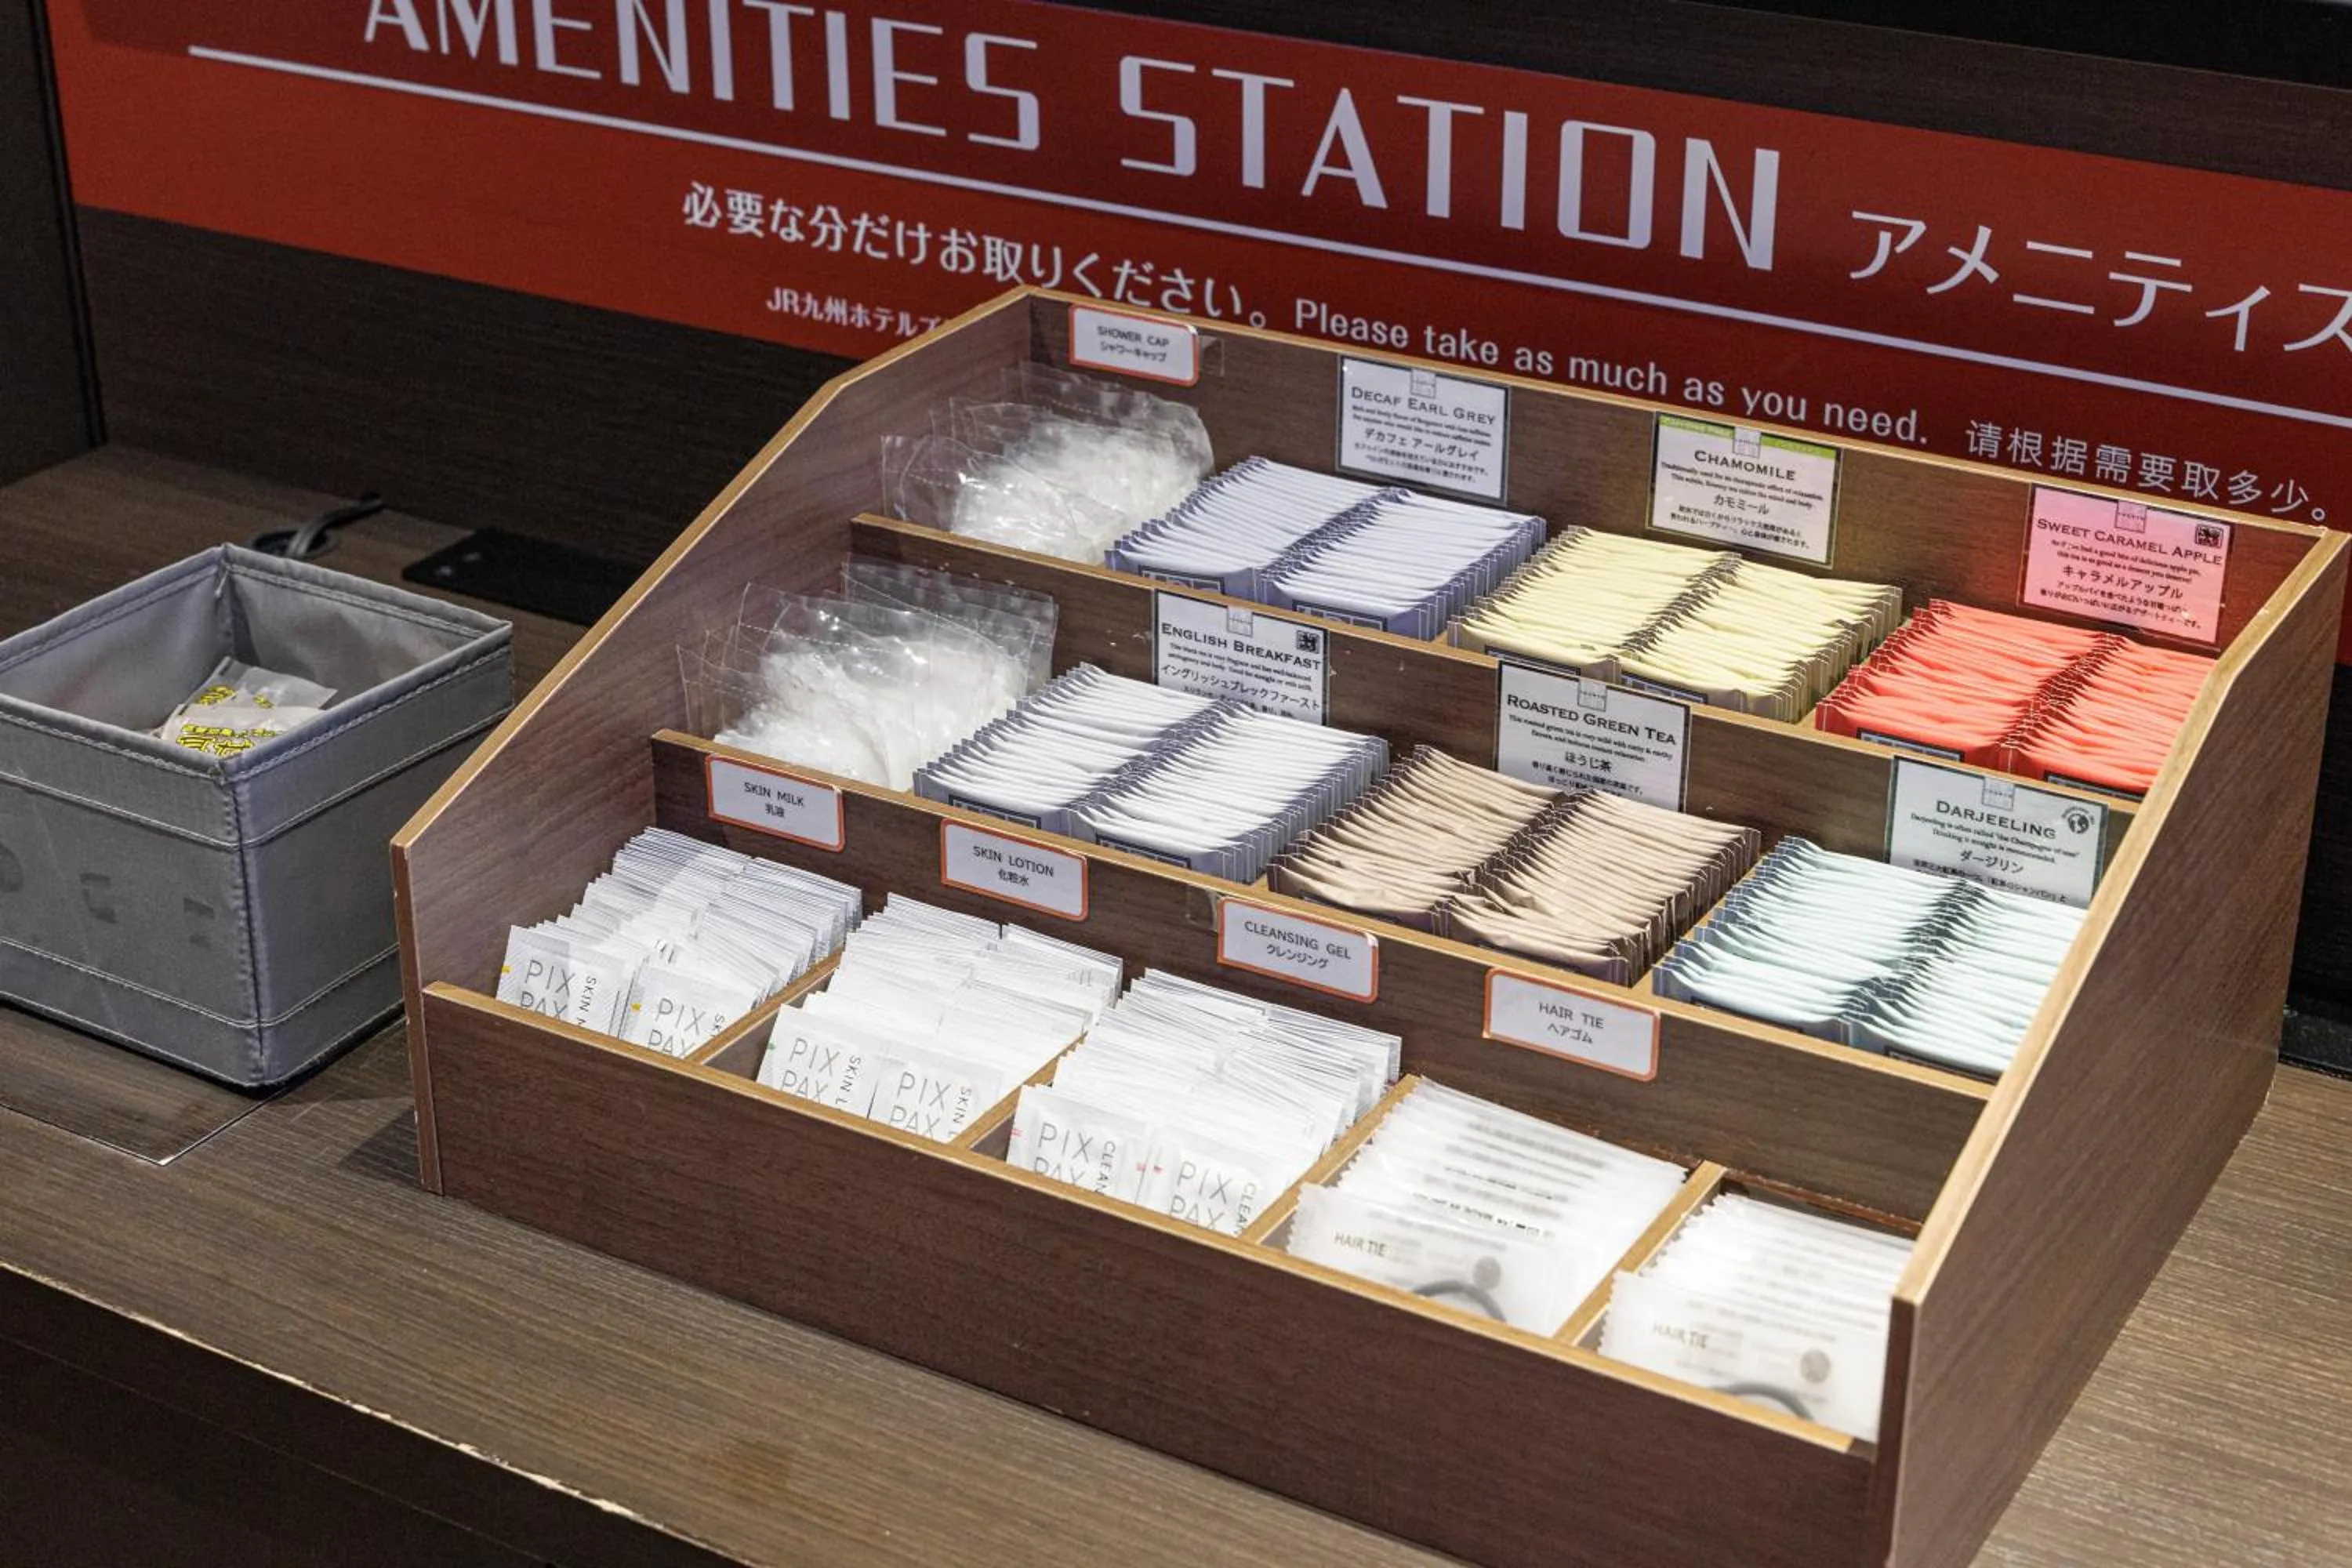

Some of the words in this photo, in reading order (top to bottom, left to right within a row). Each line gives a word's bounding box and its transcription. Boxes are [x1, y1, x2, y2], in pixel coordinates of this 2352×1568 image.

[1119, 55, 1780, 271] STATION
[683, 181, 1265, 329] 必要な分だけお取りください。
[1097, 325, 1142, 343] SHOWER
[1146, 335, 1170, 347] CAP
[1295, 298, 1410, 349] Please
[1424, 325, 1499, 366] take
[1514, 347, 1554, 376] as
[1568, 356, 1668, 396] much
[1683, 377, 1725, 407] as
[1740, 387, 1807, 421] you
[1824, 402, 1928, 445] need.
[1351, 386, 1403, 406] DECAF
[1407, 397, 1449, 417] EARL
[1453, 407, 1497, 426] GREY
[1693, 449, 1796, 481] CHAMOMILE
[1965, 419, 2327, 522] 请根据需要取多少。
[1713, 494, 1770, 516] カモミール
[2037, 518, 2092, 539] SWEET
[2094, 529, 2168, 556] CARAMEL
[2171, 546, 2223, 566] APPLE
[2062, 564, 2183, 600] キャラメルアップル
[1160, 622, 1228, 649] ENGLISH
[1232, 639, 1321, 671] BREAKFAST
[1160, 662, 1320, 711] イングリッシュブレックファースト
[1506, 693, 1580, 723] ROASTED
[1582, 713, 1640, 738] GREEN
[1644, 726, 1677, 746] TEA
[1564, 750, 1613, 774] ほうじ茶
[743, 781, 771, 798] SKIN
[777, 790, 805, 808] MILK
[764, 803, 785, 818] 乳液
[1936, 800, 2057, 840] DARJEELING
[973, 845, 1003, 863] SKIN
[1008, 855, 1054, 877] LOTION
[997, 868, 1029, 887] 化粧水
[1959, 848, 2024, 875] ダージリン
[1244, 920, 1319, 950] CLEANSING
[1326, 942, 1352, 960] GEL
[1265, 943, 1330, 969] クレンジング
[524, 959, 576, 998] PIX
[655, 997, 706, 1036] PIX
[1538, 1000, 1573, 1021] HAIR
[1581, 1012, 1606, 1029] TIE
[1547, 1022, 1594, 1044] ヘアゴム
[789, 1037, 841, 1077] PIX
[896, 1071, 952, 1112] PIX
[1038, 1121, 1094, 1163] PIX
[1177, 1160, 1233, 1205] PIX
[1334, 1230, 1365, 1252] HAIR
[1367, 1239, 1388, 1258] TIE
